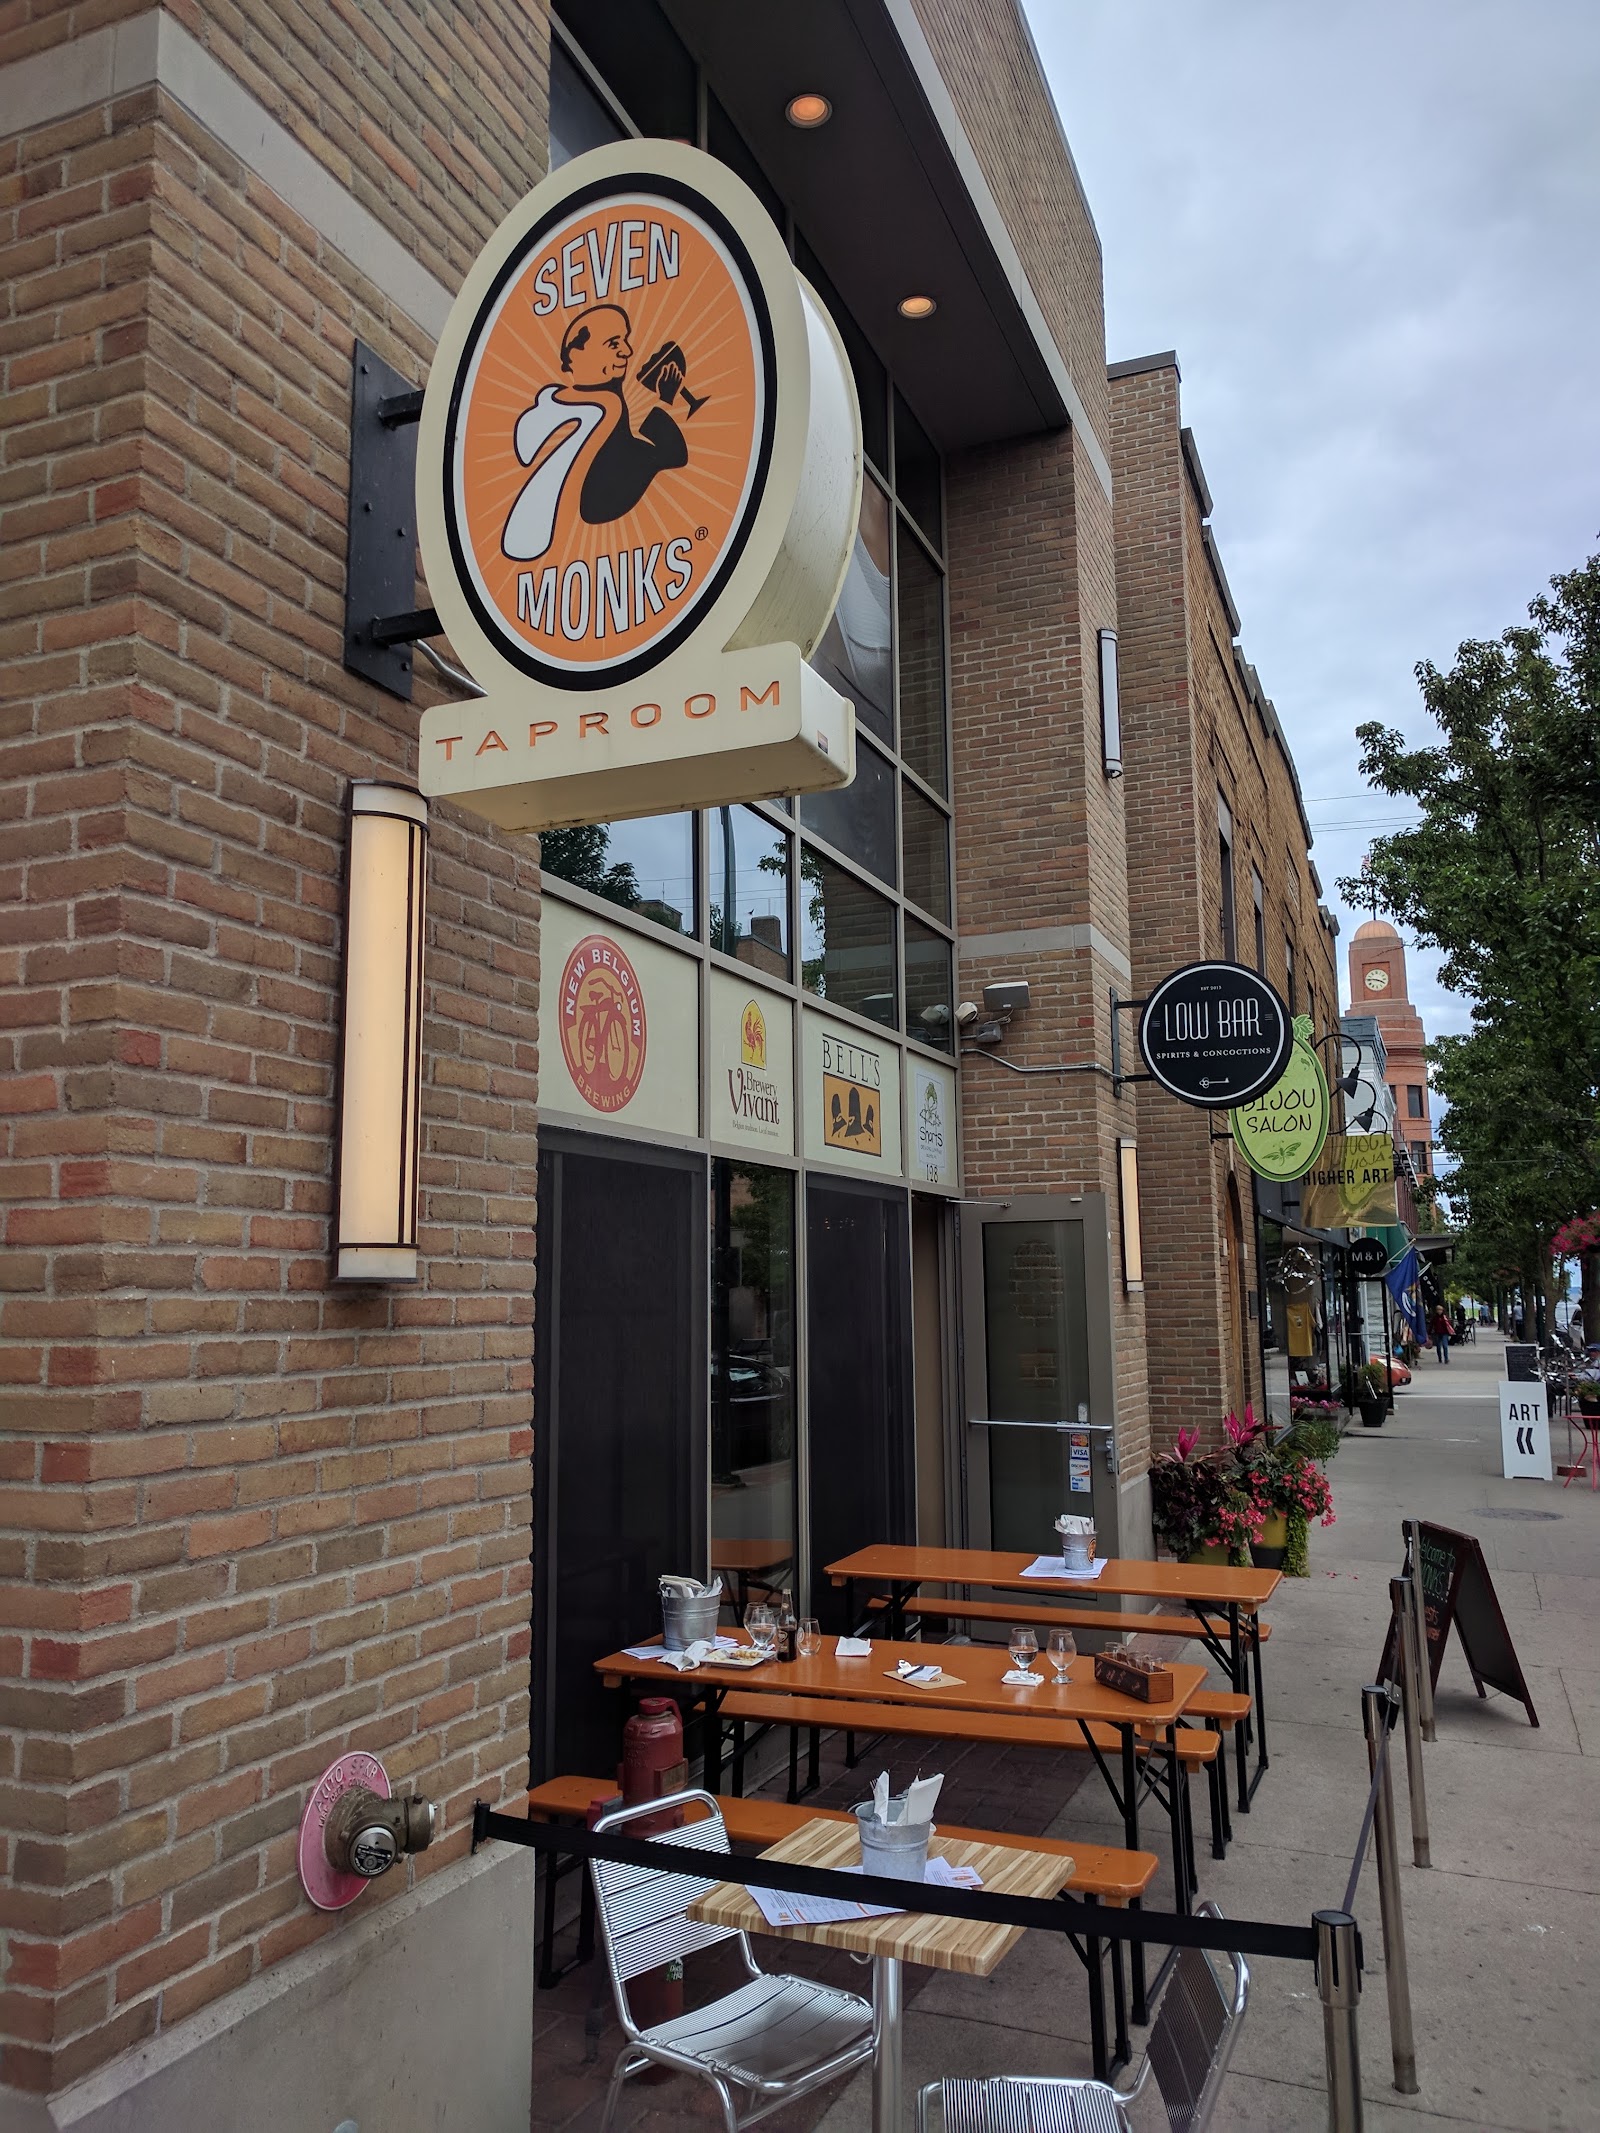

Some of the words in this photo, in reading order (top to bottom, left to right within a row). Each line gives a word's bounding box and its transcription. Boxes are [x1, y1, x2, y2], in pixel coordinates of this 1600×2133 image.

[532, 219, 681, 318] SEVEN
[515, 535, 694, 641] MONKS
[435, 680, 782, 762] TAPROOM
[565, 957, 587, 1016] NEW
[591, 948, 641, 1037] BELGIUM
[1163, 1001, 1210, 1042] LOW
[1217, 998, 1263, 1039] BAR
[822, 1039, 880, 1087] BELL'S
[1156, 1051, 1191, 1060] SPIRITS
[1193, 1050, 1200, 1058] &
[1202, 1047, 1272, 1058] CONCOCTIONS
[577, 1073, 631, 1108] BREWING
[728, 1067, 780, 1125] Vivant
[746, 1070, 778, 1097] Brewery
[1246, 1113, 1312, 1134] SALON
[1302, 1169, 1355, 1186] HIGHER
[1362, 1168, 1389, 1184] ART
[1508, 1403, 1541, 1422] ART
